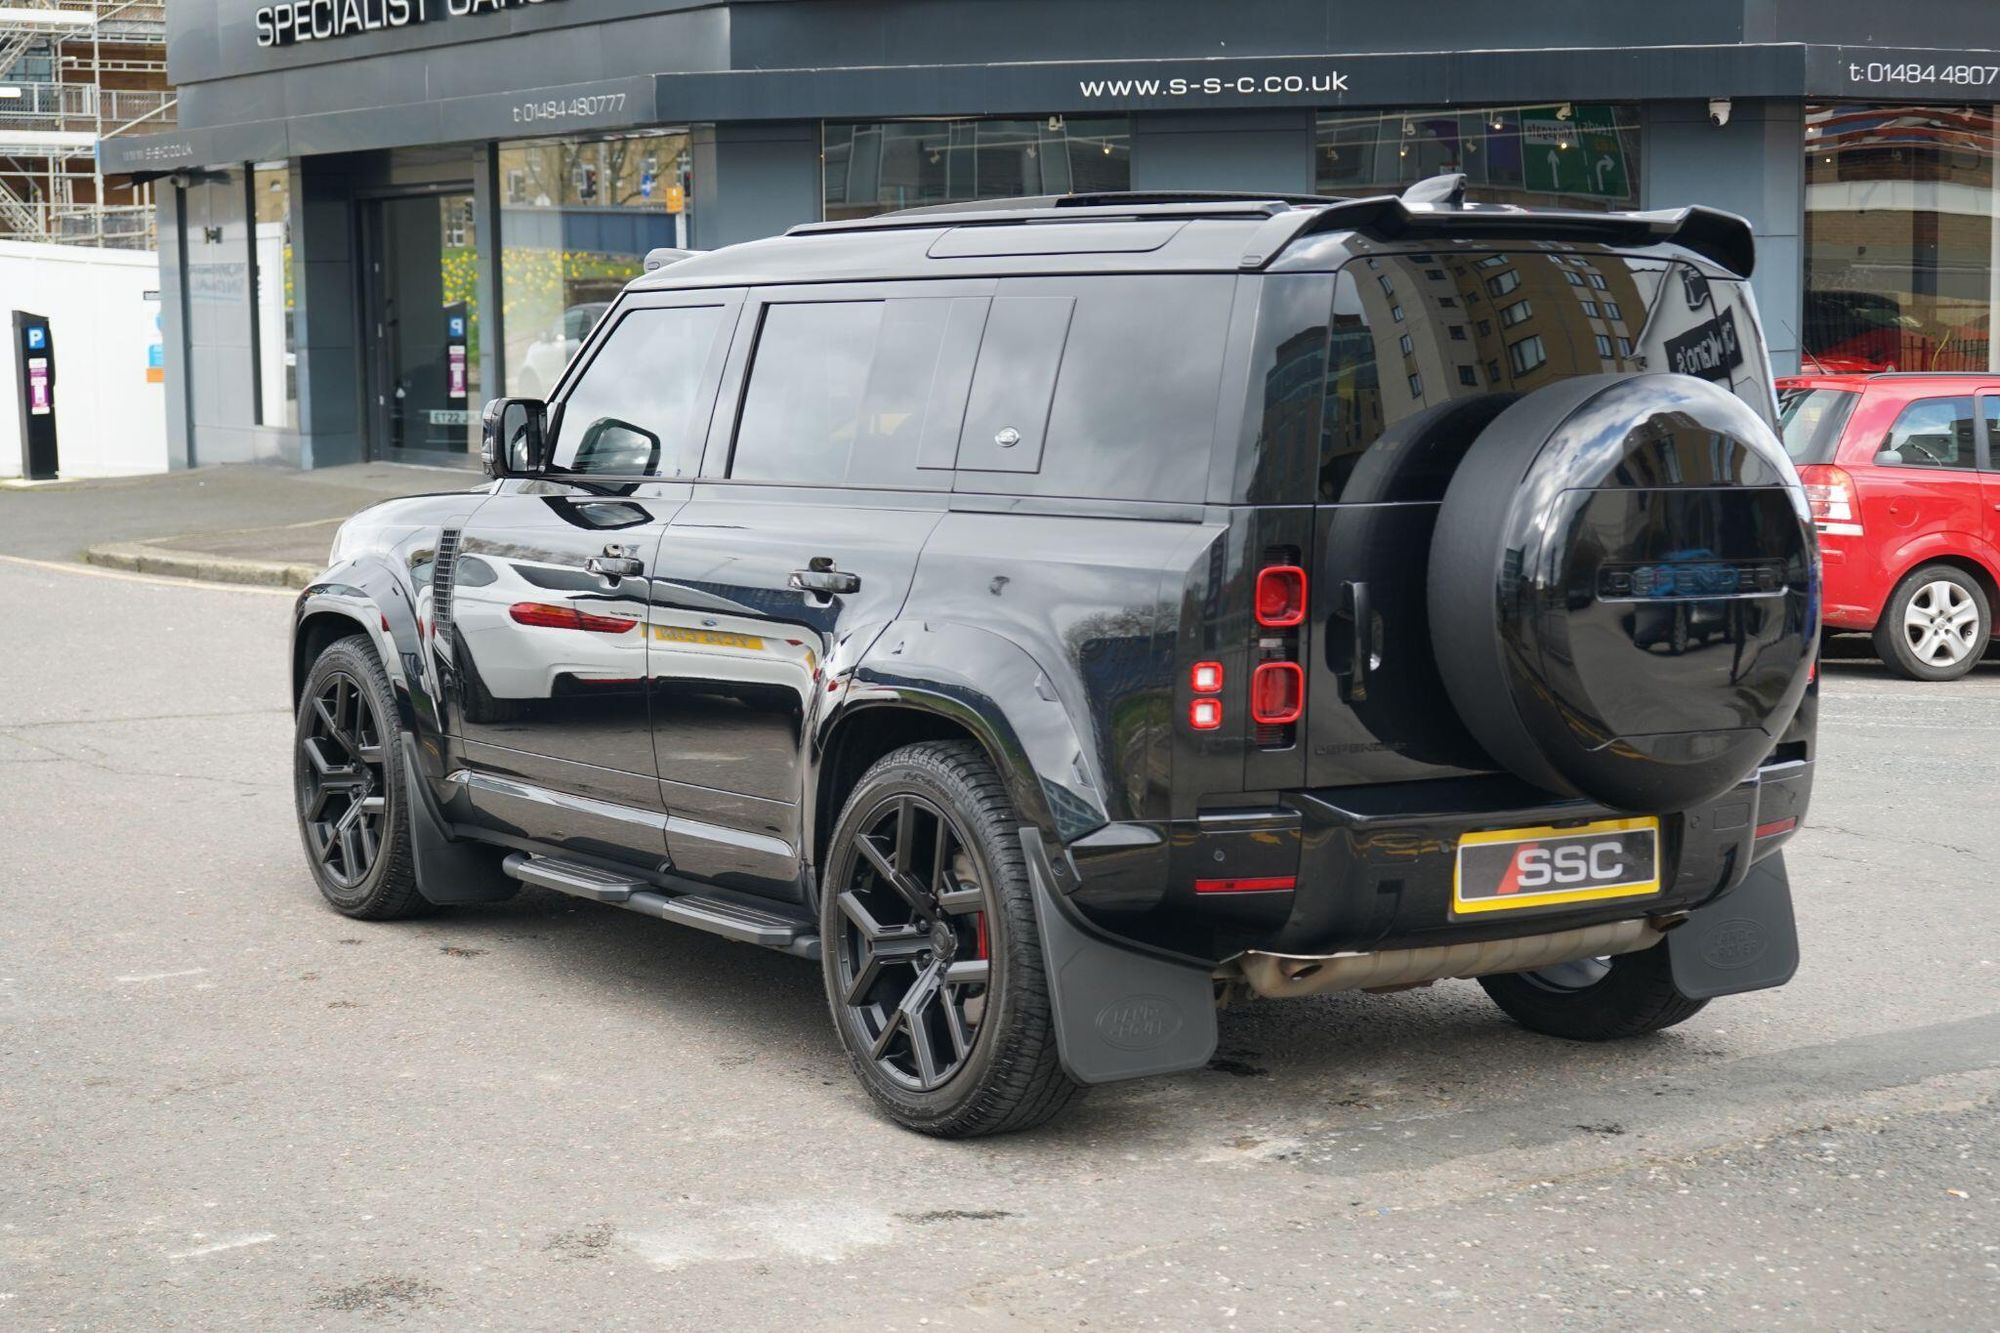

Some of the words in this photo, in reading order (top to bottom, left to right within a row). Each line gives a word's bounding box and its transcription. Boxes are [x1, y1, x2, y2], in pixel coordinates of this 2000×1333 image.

[1079, 70, 1349, 97] www.s-s-c.co.uk
[28, 328, 43, 347] P
[1517, 841, 1623, 887] SSC
